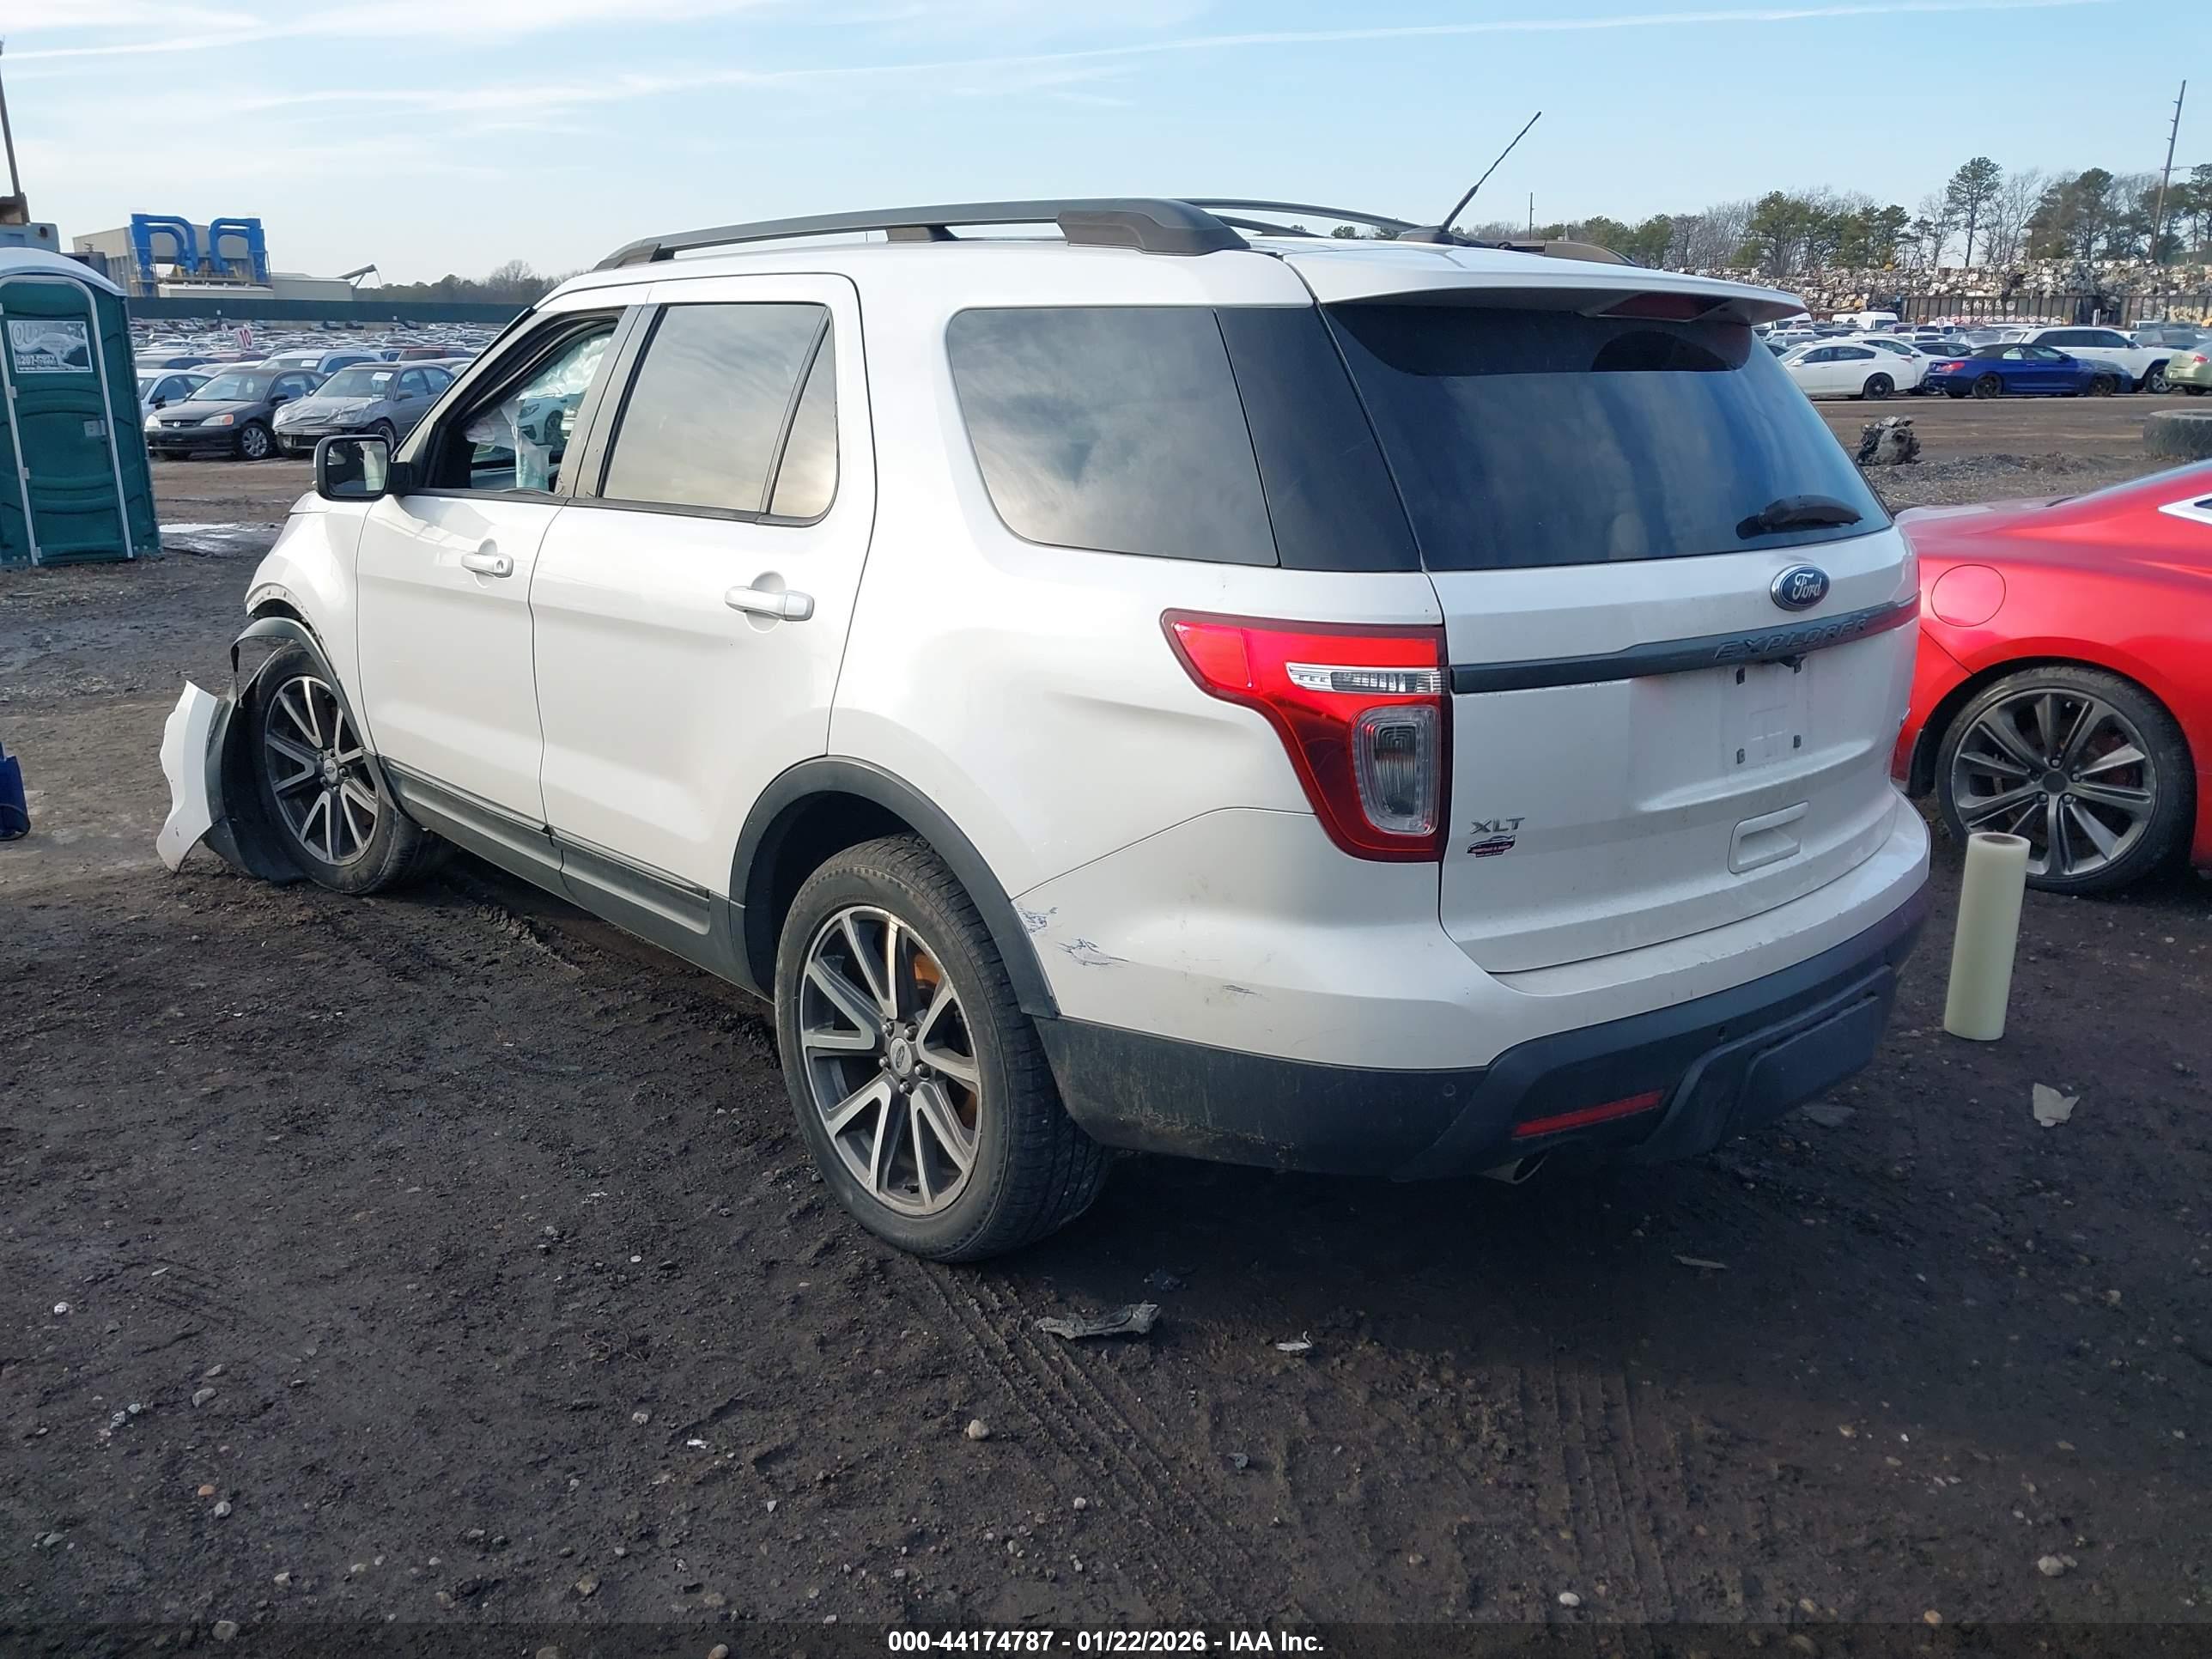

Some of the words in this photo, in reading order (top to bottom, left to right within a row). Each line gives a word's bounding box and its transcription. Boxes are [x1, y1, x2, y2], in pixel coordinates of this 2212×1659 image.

[240, 329, 252, 348] 10
[1792, 573, 1822, 600] Ford
[1714, 618, 1867, 660] EXPLORER
[1470, 817, 1526, 835] XLT
